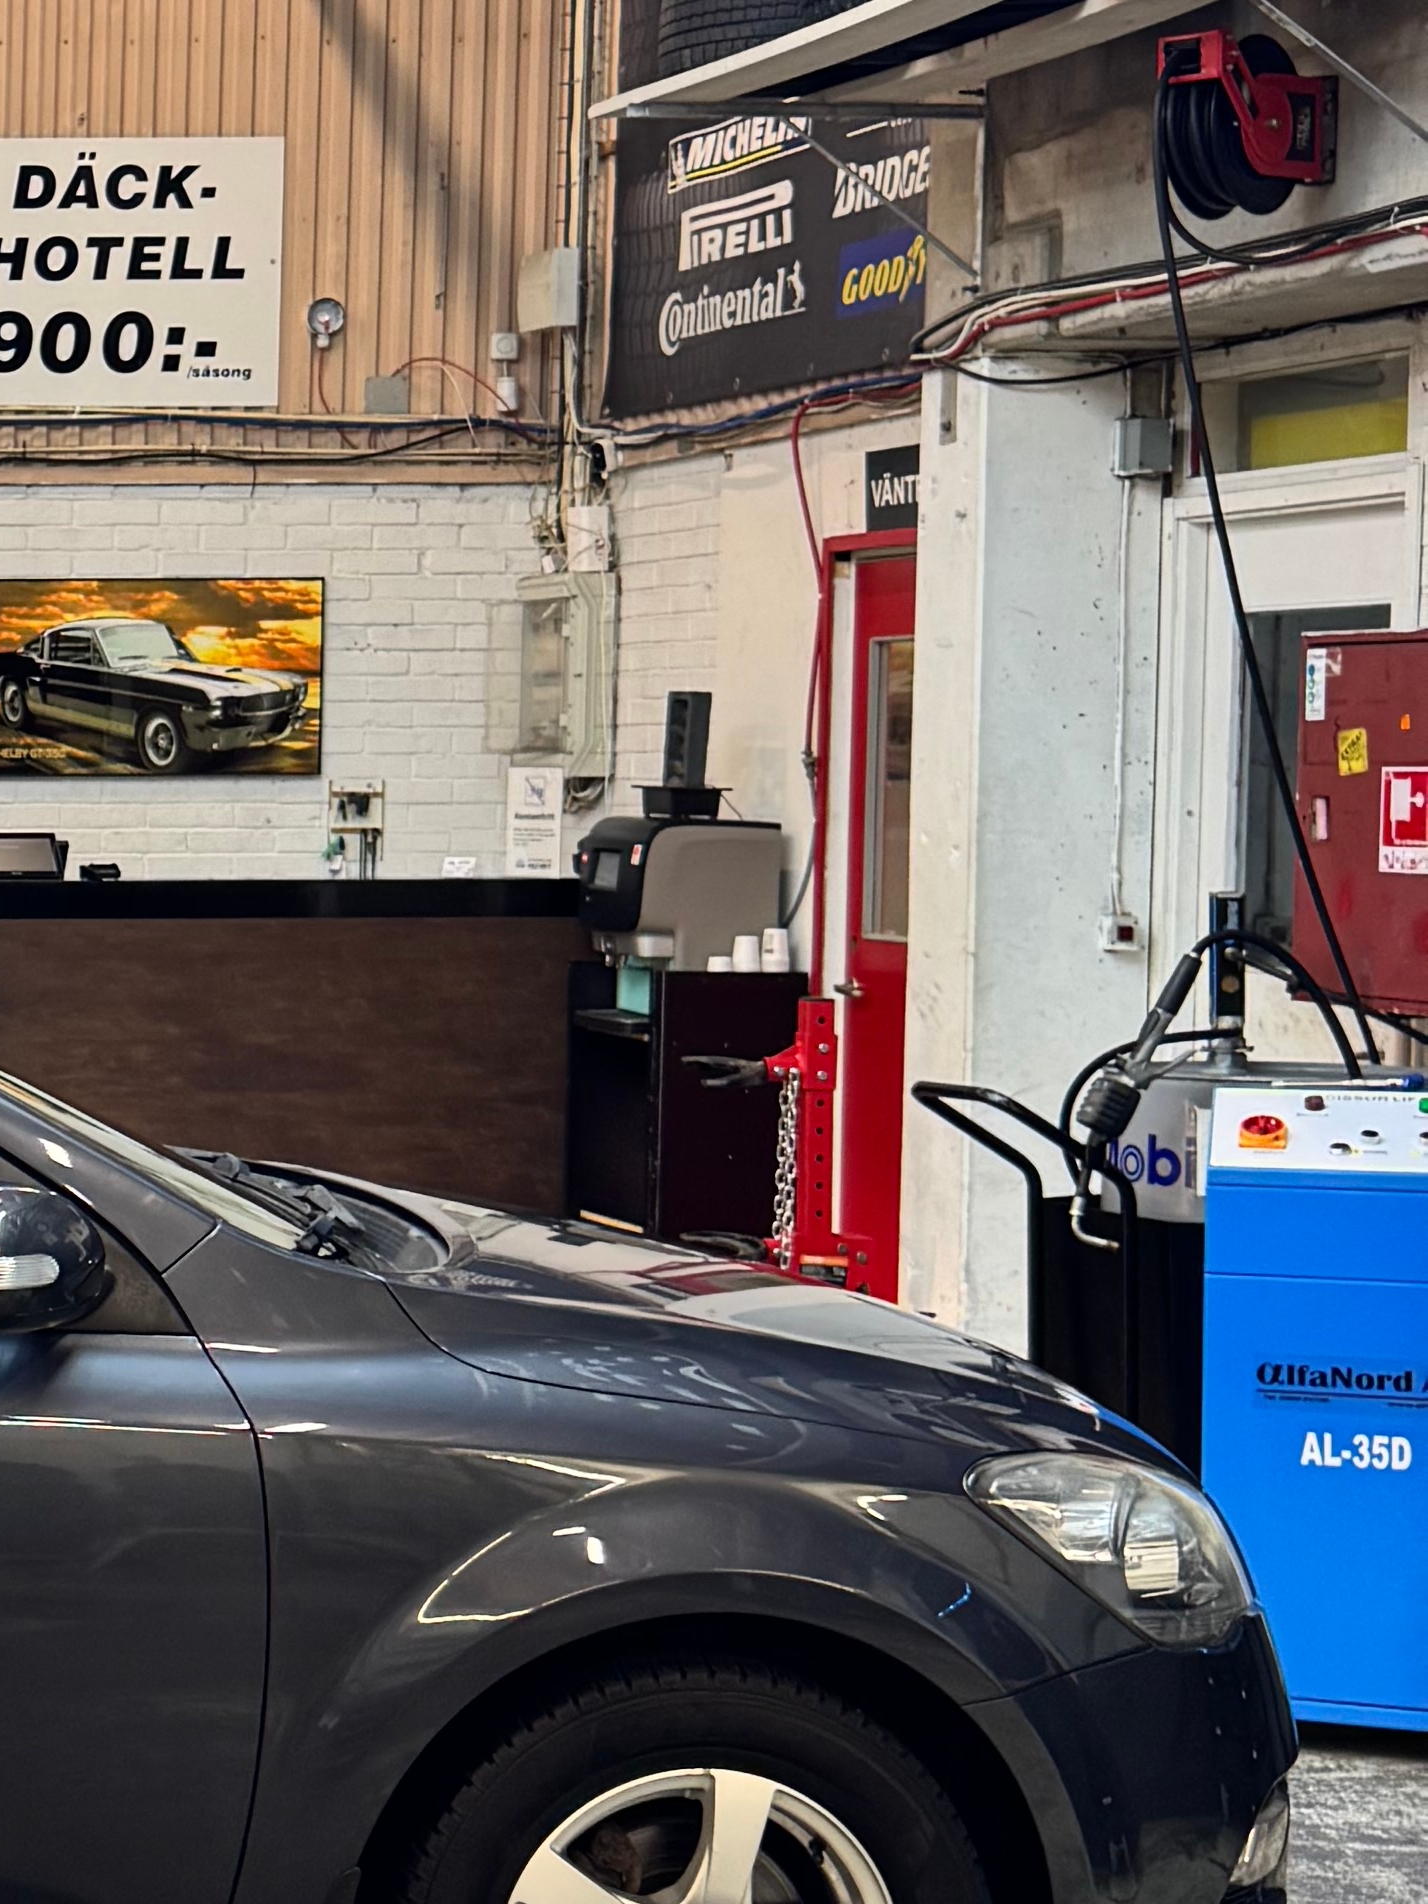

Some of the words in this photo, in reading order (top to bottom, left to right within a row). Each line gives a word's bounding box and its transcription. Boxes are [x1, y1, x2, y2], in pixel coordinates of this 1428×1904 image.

[12, 151, 217, 210] DÄCK-
[832, 145, 931, 219] BRIDGE
[677, 179, 794, 272] PIRELLI
[658, 266, 787, 356] Continental
[870, 472, 919, 508] VÄNT
[1300, 1431, 1412, 1471] AL-35D
